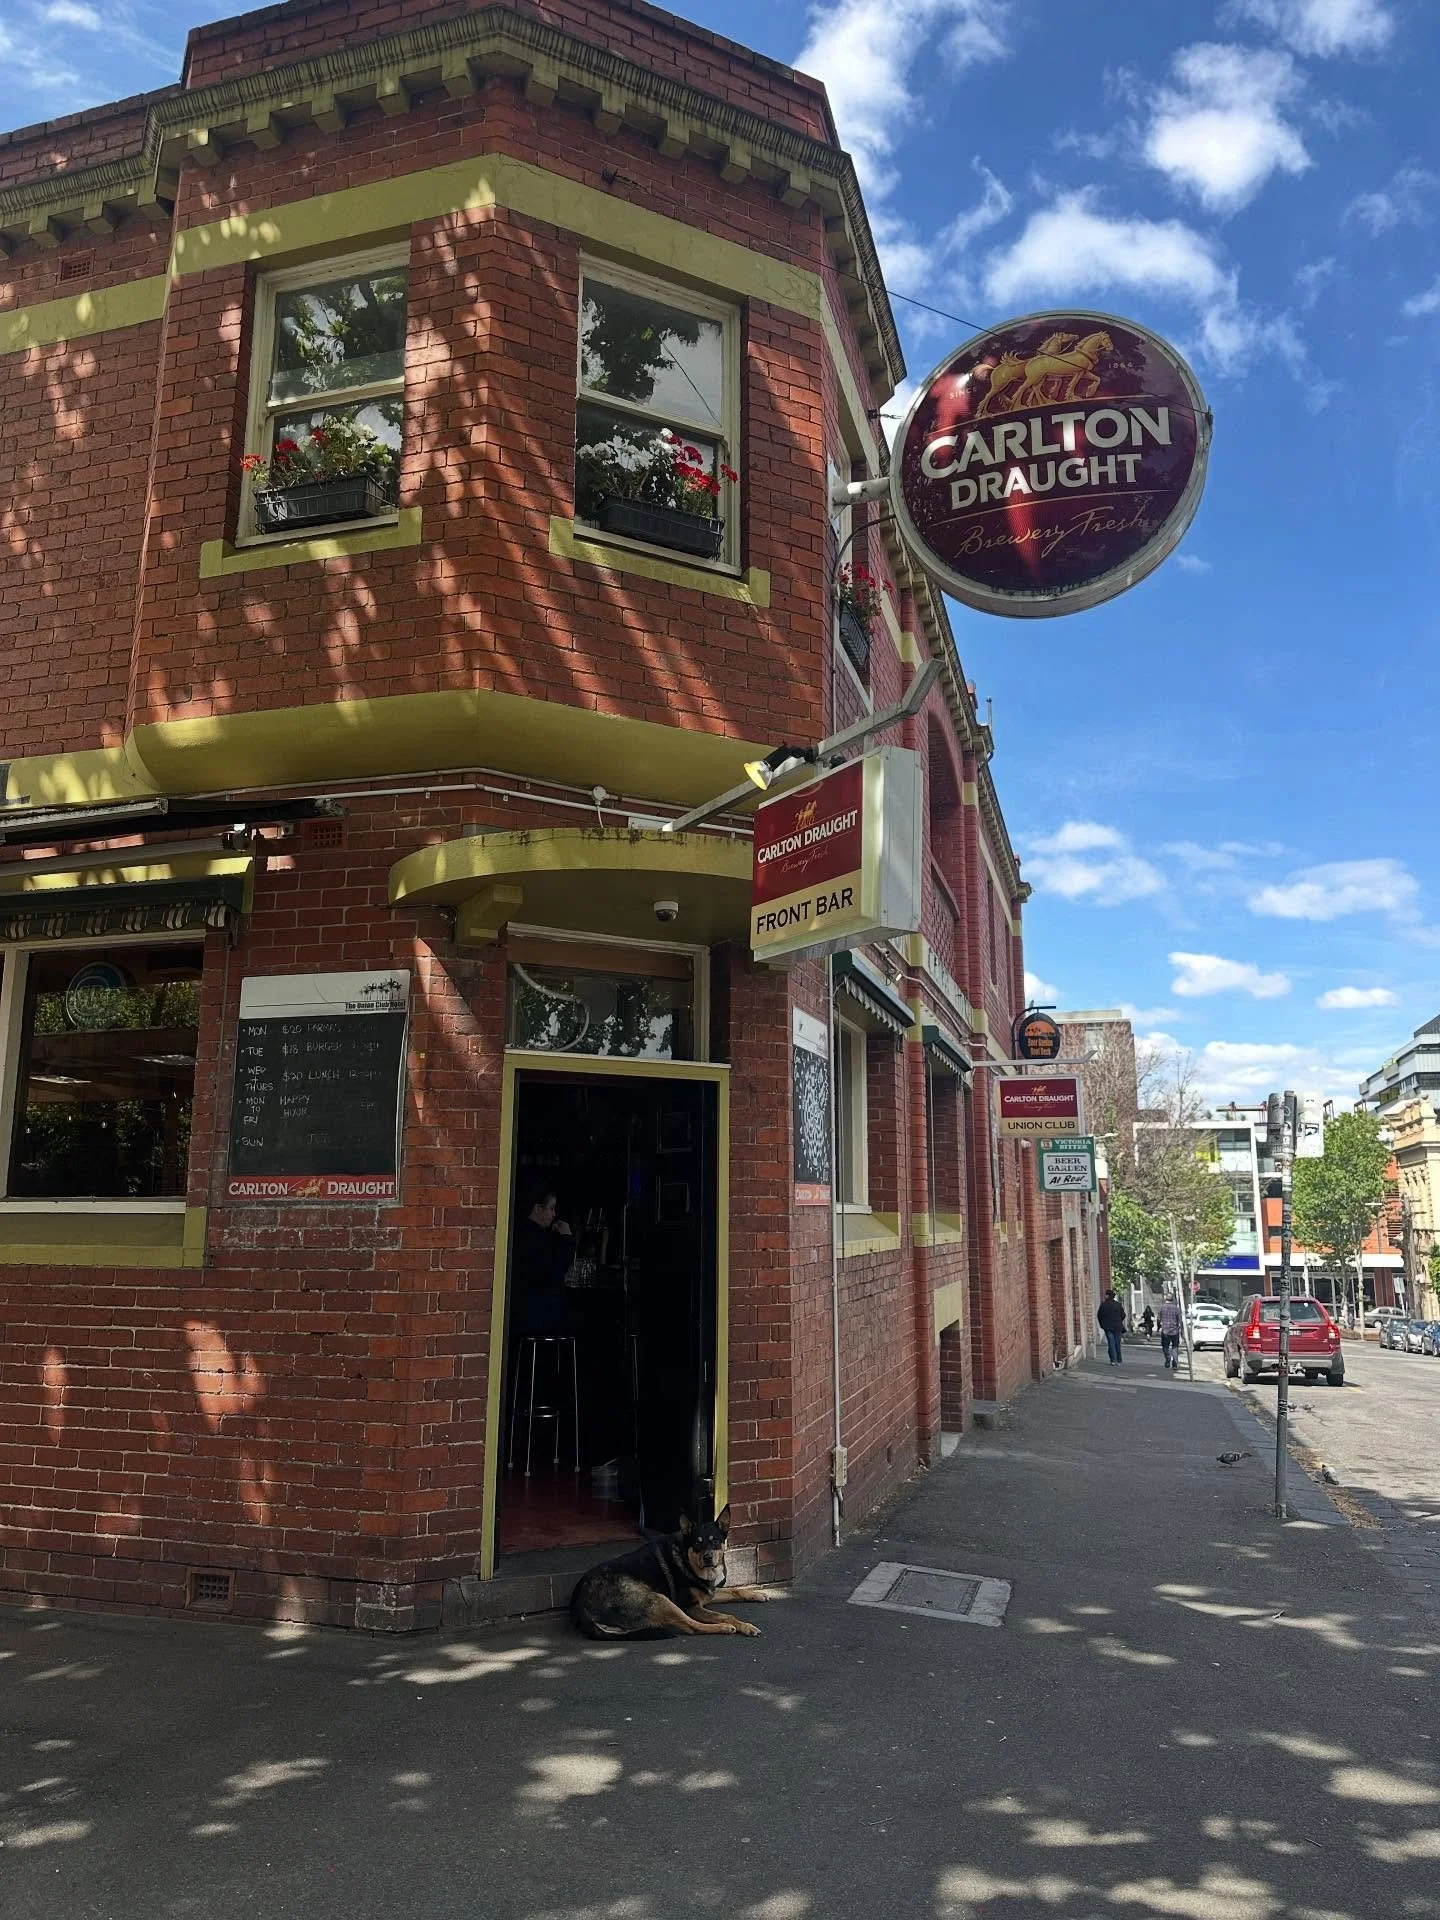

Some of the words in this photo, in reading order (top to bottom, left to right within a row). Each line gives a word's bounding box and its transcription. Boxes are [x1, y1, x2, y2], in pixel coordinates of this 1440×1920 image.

[949, 388, 978, 399] SINCE
[920, 406, 1172, 479] CARLTON
[949, 452, 1143, 511] DRAUGHT
[954, 524, 1067, 558] Brewery
[1070, 503, 1150, 537] Fresh
[757, 833, 802, 864] CARLTON
[804, 810, 858, 846] DRAUGHT
[756, 900, 812, 935] FRONT
[815, 887, 853, 917] BAR
[247, 1026, 268, 1037] MON
[247, 1047, 264, 1057] TUE
[247, 1066, 267, 1075] WED
[308, 1070, 340, 1080] LUNCH
[245, 1082, 275, 1092] THURS
[246, 1096, 266, 1106] MON
[279, 1095, 311, 1106] HAPPY
[1004, 1095, 1038, 1103] CARLTON
[1038, 1094, 1075, 1102] DRAUGHT
[243, 1116, 258, 1125] FRI
[1008, 1121, 1043, 1130] UNION
[1044, 1121, 1076, 1130] CLUB
[241, 1136, 264, 1147] SUN
[228, 1182, 289, 1196] CARLTON
[327, 1181, 395, 1196] DRAUGHT
